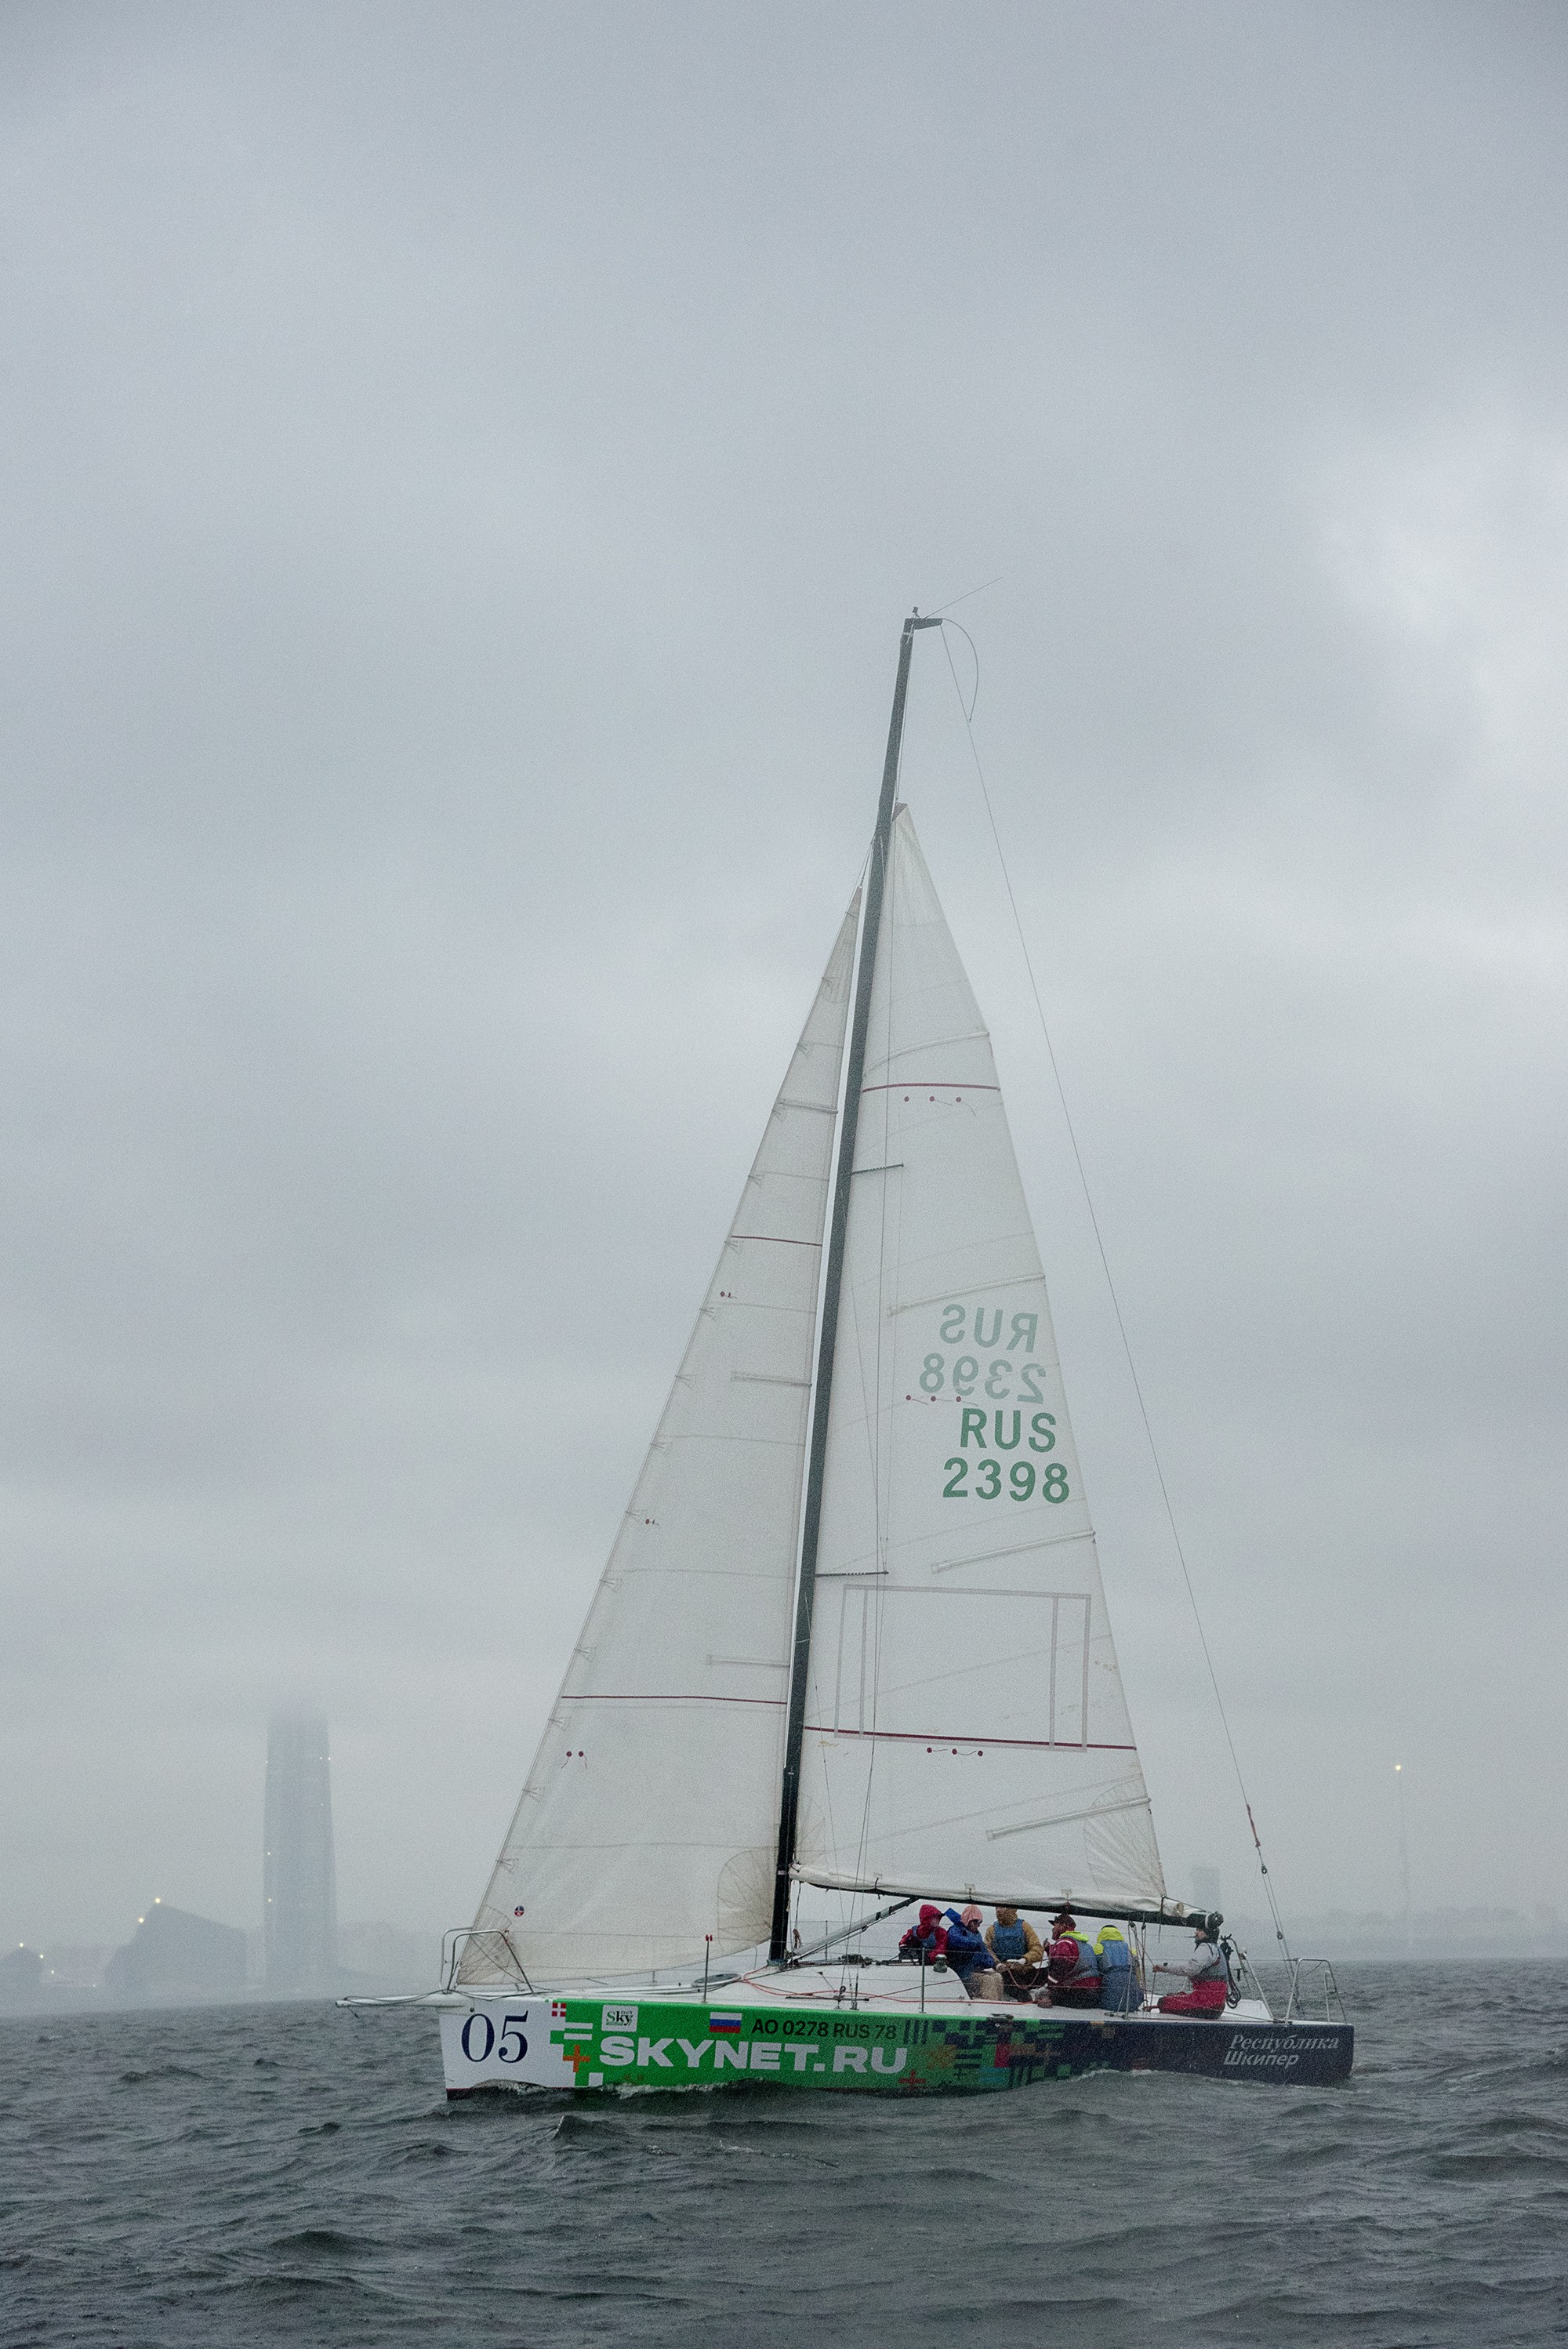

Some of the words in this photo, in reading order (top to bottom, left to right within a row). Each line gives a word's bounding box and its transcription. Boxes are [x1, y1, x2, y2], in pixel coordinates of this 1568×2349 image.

[960, 1407, 1057, 1453] RUS
[942, 1457, 1070, 1504] 2398
[606, 2010, 633, 2026] Sky
[783, 2020, 829, 2037] 0278
[833, 2023, 870, 2039] RUS
[873, 2024, 897, 2039] 78
[460, 2010, 530, 2064] 05
[1229, 2034, 1339, 2053] Республика
[600, 2036, 908, 2074] SKYNET.RU
[1223, 2050, 1299, 2070] Шкипер
